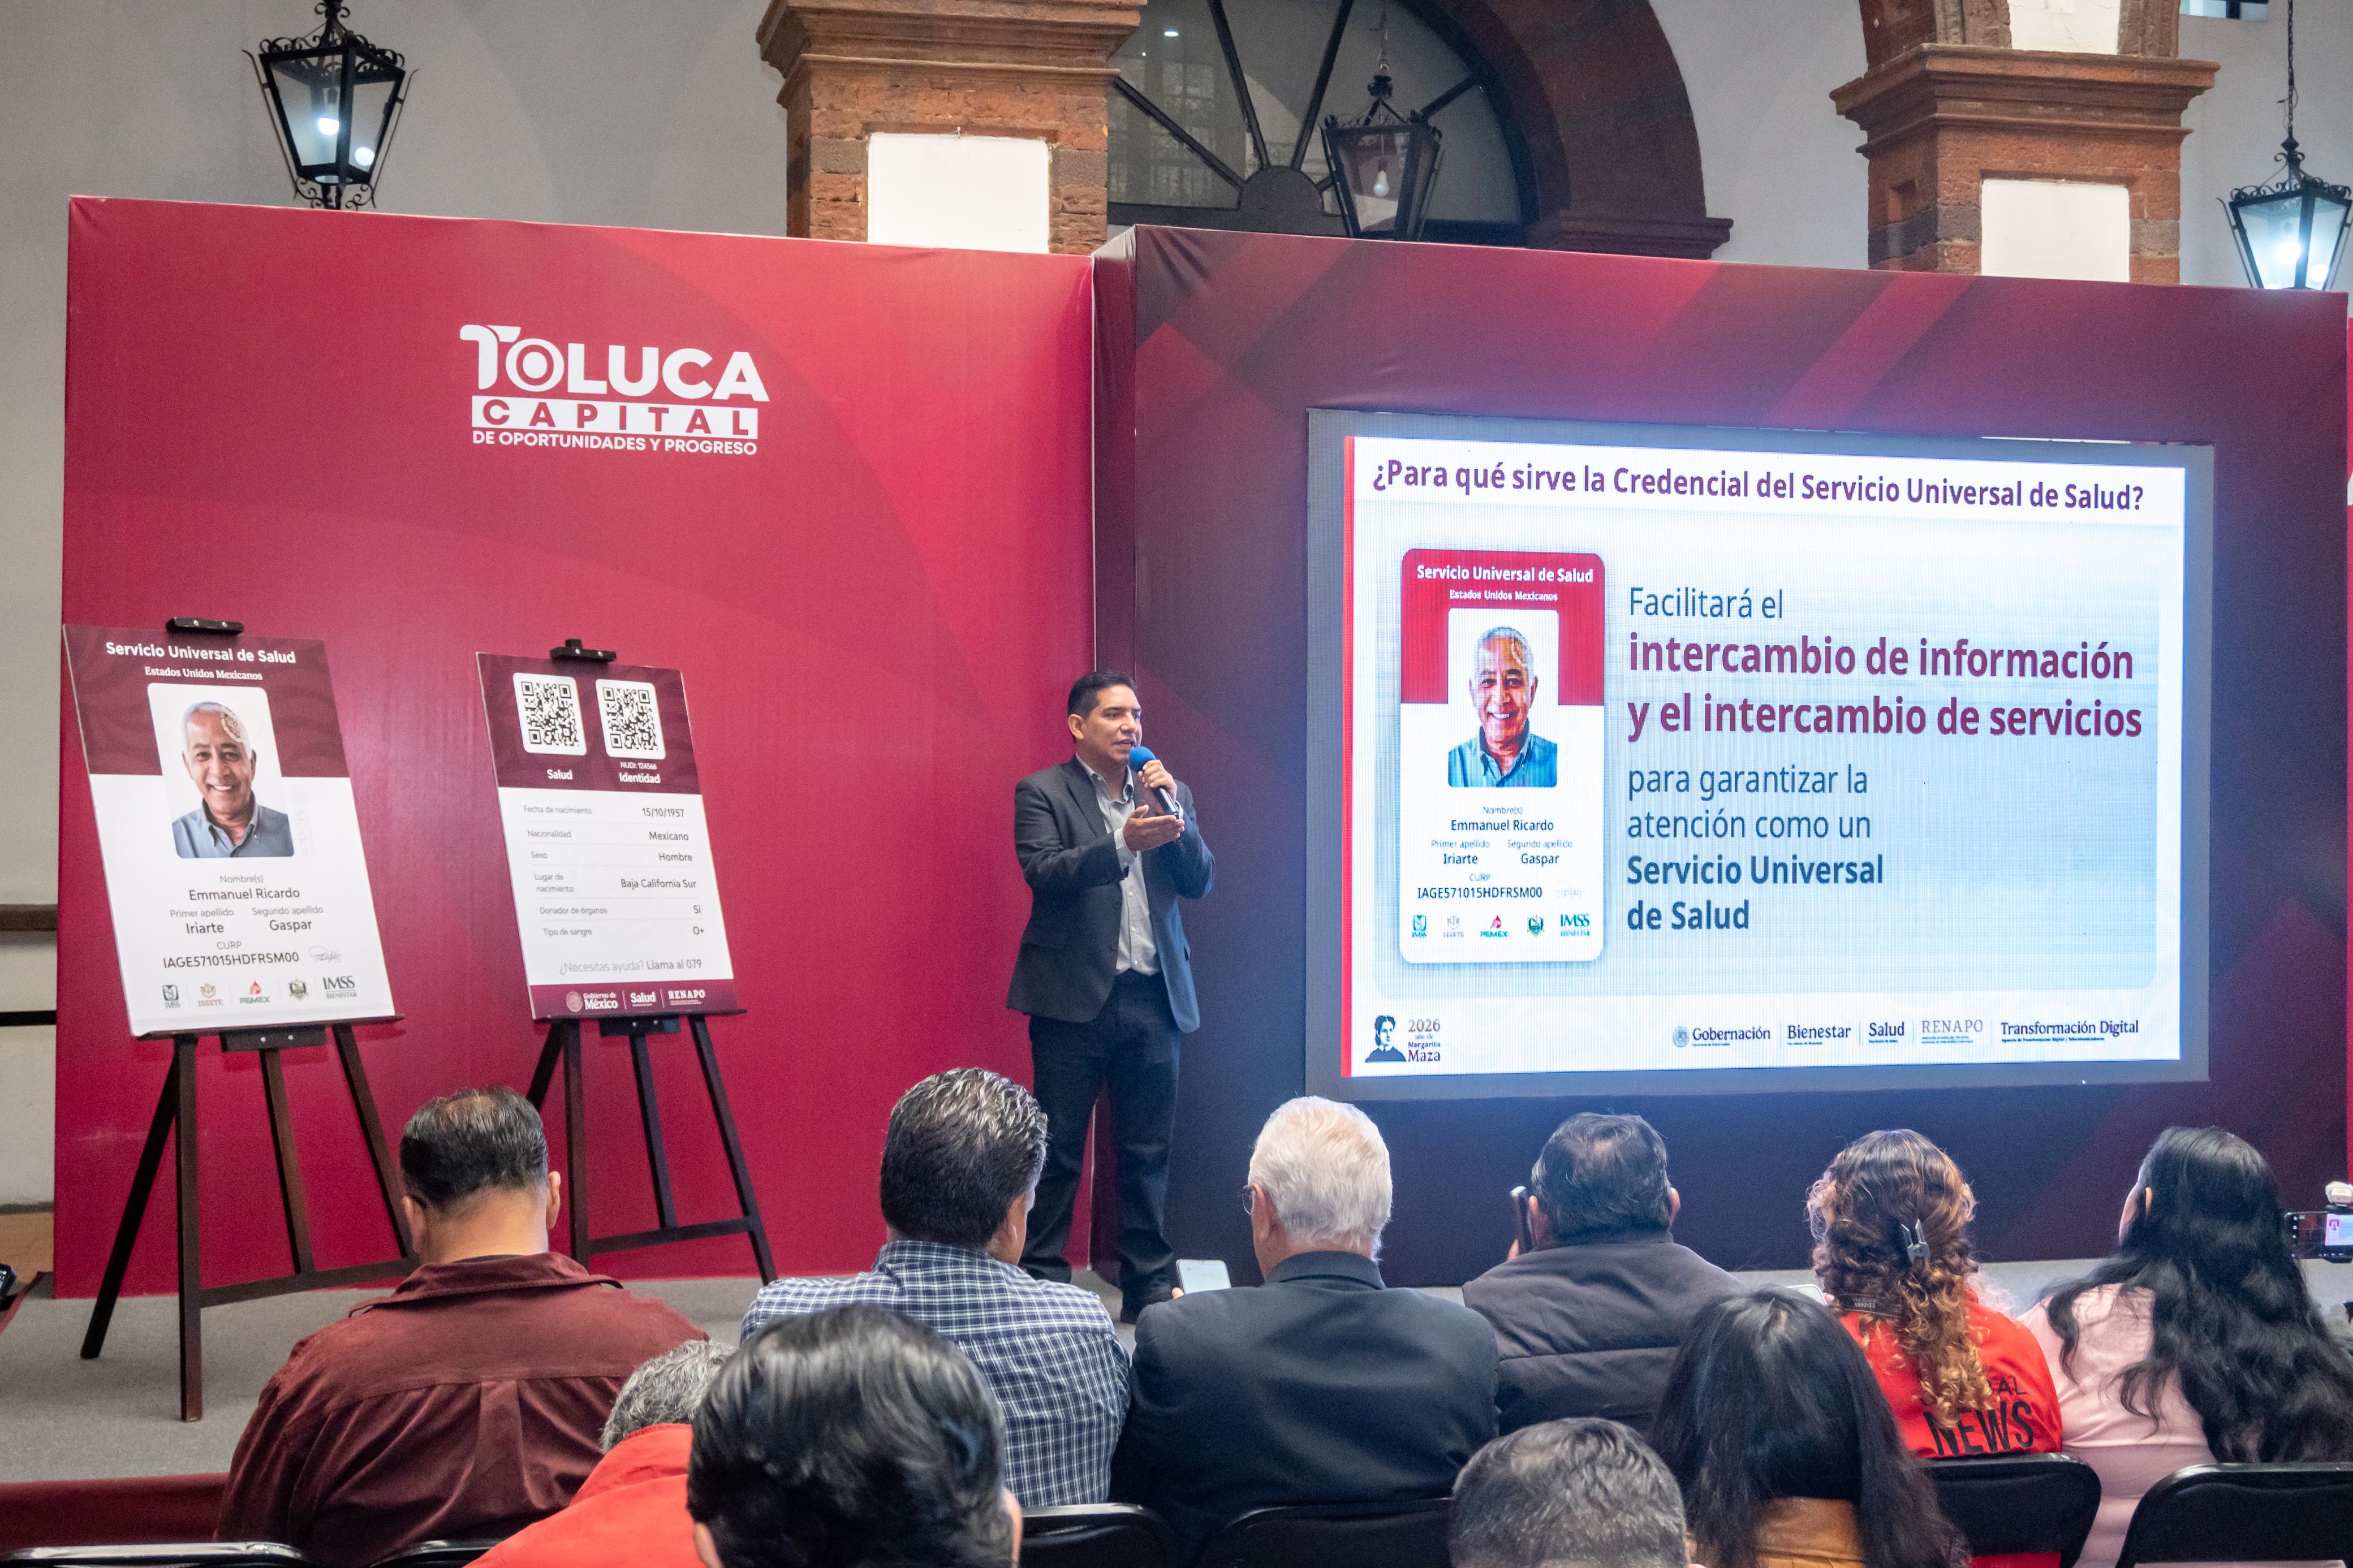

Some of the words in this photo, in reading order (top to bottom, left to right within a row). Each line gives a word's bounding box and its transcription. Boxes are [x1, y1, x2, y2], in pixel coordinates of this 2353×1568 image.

[460, 325, 770, 402] TOLUCA
[482, 399, 748, 435] CAPITAL
[472, 431, 494, 444] DE
[499, 431, 646, 451] OPORTUNIDADES
[649, 438, 661, 451] Y
[665, 439, 757, 455] PROGRESO
[1373, 459, 1447, 491] ¿Para
[1455, 462, 1505, 495] qué
[1512, 464, 1576, 491] sirve
[1584, 466, 1605, 491] la
[1614, 468, 1748, 497] Credencial
[1757, 472, 1794, 499] del
[1802, 474, 1899, 502] Servicio
[1907, 478, 2022, 507] Universal
[2029, 482, 2058, 508] de
[2065, 483, 2144, 510] Salud?
[1417, 565, 1469, 580] Servicio
[1473, 566, 1535, 581] Universal
[1538, 568, 1554, 582] de
[1557, 568, 1593, 583] Salud
[1450, 589, 1482, 600] Estados
[1484, 590, 1512, 601] Unidos
[1515, 591, 1558, 602] Mexicanos
[1630, 587, 1752, 619] Facilitará
[1761, 589, 1783, 619] el
[106, 642, 165, 658] Servicio
[168, 645, 233, 661] Universal
[237, 649, 254, 662] de
[257, 650, 296, 664] Salud
[1629, 632, 1855, 675] intercambio
[1866, 637, 1909, 675] de
[1920, 638, 2134, 680] información
[145, 666, 181, 677] Estados
[182, 668, 214, 679] Unidos
[216, 669, 262, 680] Mexicanos
[1627, 699, 1650, 742] y
[1659, 693, 1692, 732] el
[1704, 693, 1926, 735] intercambio
[1937, 697, 1980, 736] de
[1990, 699, 2143, 737] servicios
[546, 769, 574, 780] Salud
[619, 772, 661, 784] Identidad
[1628, 766, 1690, 801] para
[1699, 763, 1839, 802] garantizar
[1847, 764, 1868, 793] la
[642, 807, 684, 818] 15/10/1957
[1451, 820, 1510, 831] Emmanuel
[1513, 820, 1554, 831] Ricardo
[1627, 809, 1746, 838] atención
[1755, 815, 1829, 838] como
[1838, 815, 1872, 838] un
[527, 830, 571, 838] Nacionalidad
[649, 831, 689, 841] Mexicano
[1507, 840, 1540, 850] Segundo
[658, 853, 692, 862] Hombre
[1443, 853, 1478, 864] Iriarte
[1521, 853, 1559, 867] Gaspar
[1627, 854, 1742, 885] Servicio
[1751, 854, 1884, 885] Universal
[220, 874, 264, 884] Nombre(s)
[534, 873, 554, 882] Lugar
[621, 879, 639, 890] Baja
[641, 879, 680, 888] California
[682, 879, 696, 888] Sur
[189, 888, 252, 901] Emmanuel
[256, 887, 300, 899] Ricardo
[170, 909, 198, 917] Primer
[201, 908, 234, 918] apellido
[252, 906, 289, 917] Segundo
[292, 905, 324, 915] apellido
[580, 906, 607, 916] órganos
[1627, 900, 1662, 930] de
[1671, 900, 1749, 930] Salud
[269, 919, 312, 933] Gaspar
[1561, 913, 1590, 927] IMSS
[186, 922, 224, 934] Iriarte
[544, 928, 559, 937] Tipo
[570, 929, 592, 938] sangre
[217, 941, 242, 950] CURP
[163, 952, 299, 968] IAGE571015HDFRSM00
[559, 962, 610, 975] ¿Necesitas
[612, 961, 644, 974] ayuda?
[647, 961, 674, 971] Llama
[676, 960, 684, 969] al
[686, 959, 702, 969] 079
[323, 976, 355, 990] IMSS
[630, 991, 656, 1003] Salud
[668, 990, 705, 999] RENAPO
[584, 999, 618, 1009] México
[1408, 1018, 1440, 1032] 2026
[1787, 1025, 1851, 1039] Bienestar
[1869, 1022, 1904, 1036] Salud
[1921, 1020, 1983, 1033] RENAPO
[2001, 1021, 2096, 1035] Transformación
[2100, 1020, 2139, 1037] Digital
[1692, 1026, 1770, 1040] Gobernación
[1408, 1049, 1440, 1062] Maza
[1924, 1401, 2034, 1456] NEWS
